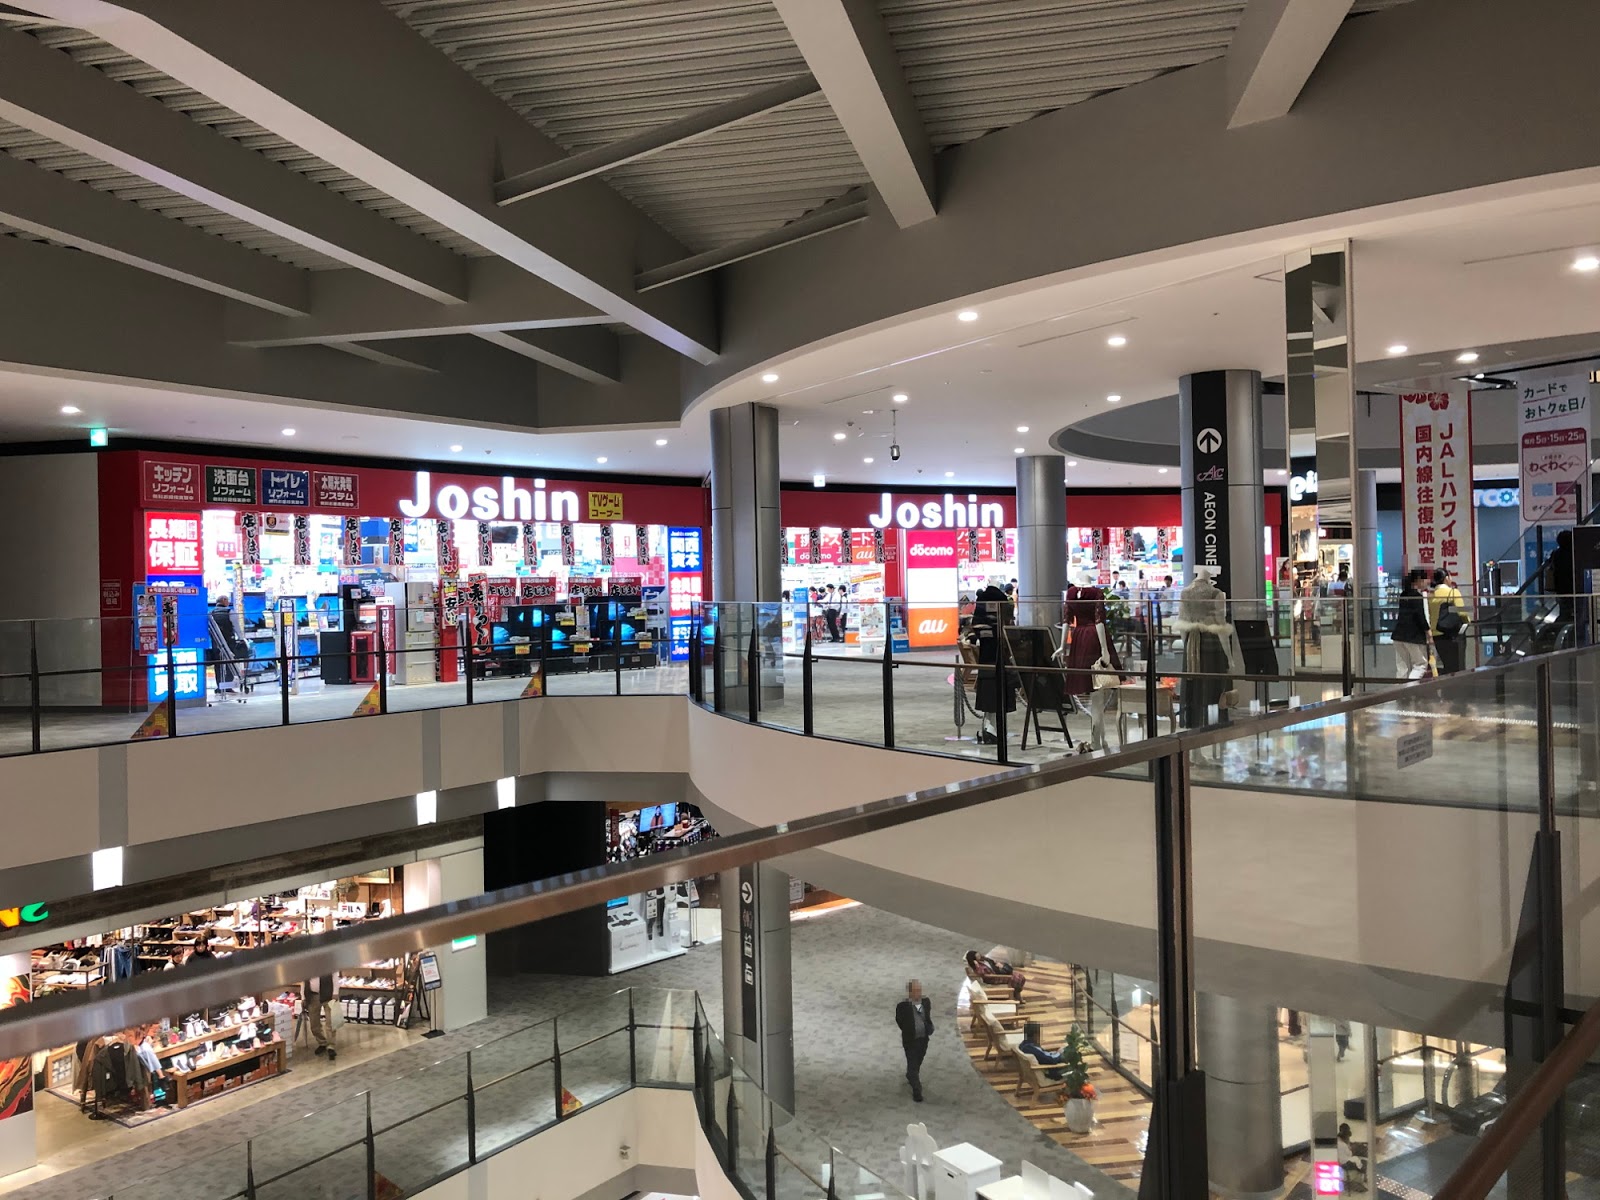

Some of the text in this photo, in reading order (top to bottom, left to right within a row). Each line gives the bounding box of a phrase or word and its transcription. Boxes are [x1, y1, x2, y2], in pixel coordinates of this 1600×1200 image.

[1523, 382, 1567, 399] カードで
[1524, 397, 1586, 420] おトクな日!
[154, 465, 192, 482] キッチン
[213, 469, 250, 487] 洗面台
[270, 471, 301, 488] トイレ
[321, 475, 353, 492] 太陽光発電
[152, 483, 194, 494] リフォーム
[212, 486, 251, 496] リフォーム
[268, 489, 304, 499] リフォーム
[320, 491, 354, 501] システム
[399, 471, 579, 521] Joshin
[1439, 423, 1459, 577] JALハワイ線に
[869, 492, 1004, 528] Joshin
[149, 518, 187, 539] 長期
[242, 513, 260, 564] 店じまい
[294, 515, 311, 565] 店じまい
[345, 516, 362, 565] 店じまい
[1204, 491, 1221, 588] AEON CINEA
[149, 541, 199, 566] 保証
[389, 519, 404, 565] 店じまい
[437, 520, 452, 566] 店じまい
[478, 521, 492, 566] 店じまい
[523, 523, 537, 565] 店じまい
[561, 523, 575, 565] 店じまい
[600, 524, 614, 565] 店じまい
[636, 525, 650, 565] 店じまい
[909, 543, 955, 556] docomo
[523, 585, 556, 598] 店じまい
[918, 619, 948, 635] au
[341, 905, 362, 914] FILA
